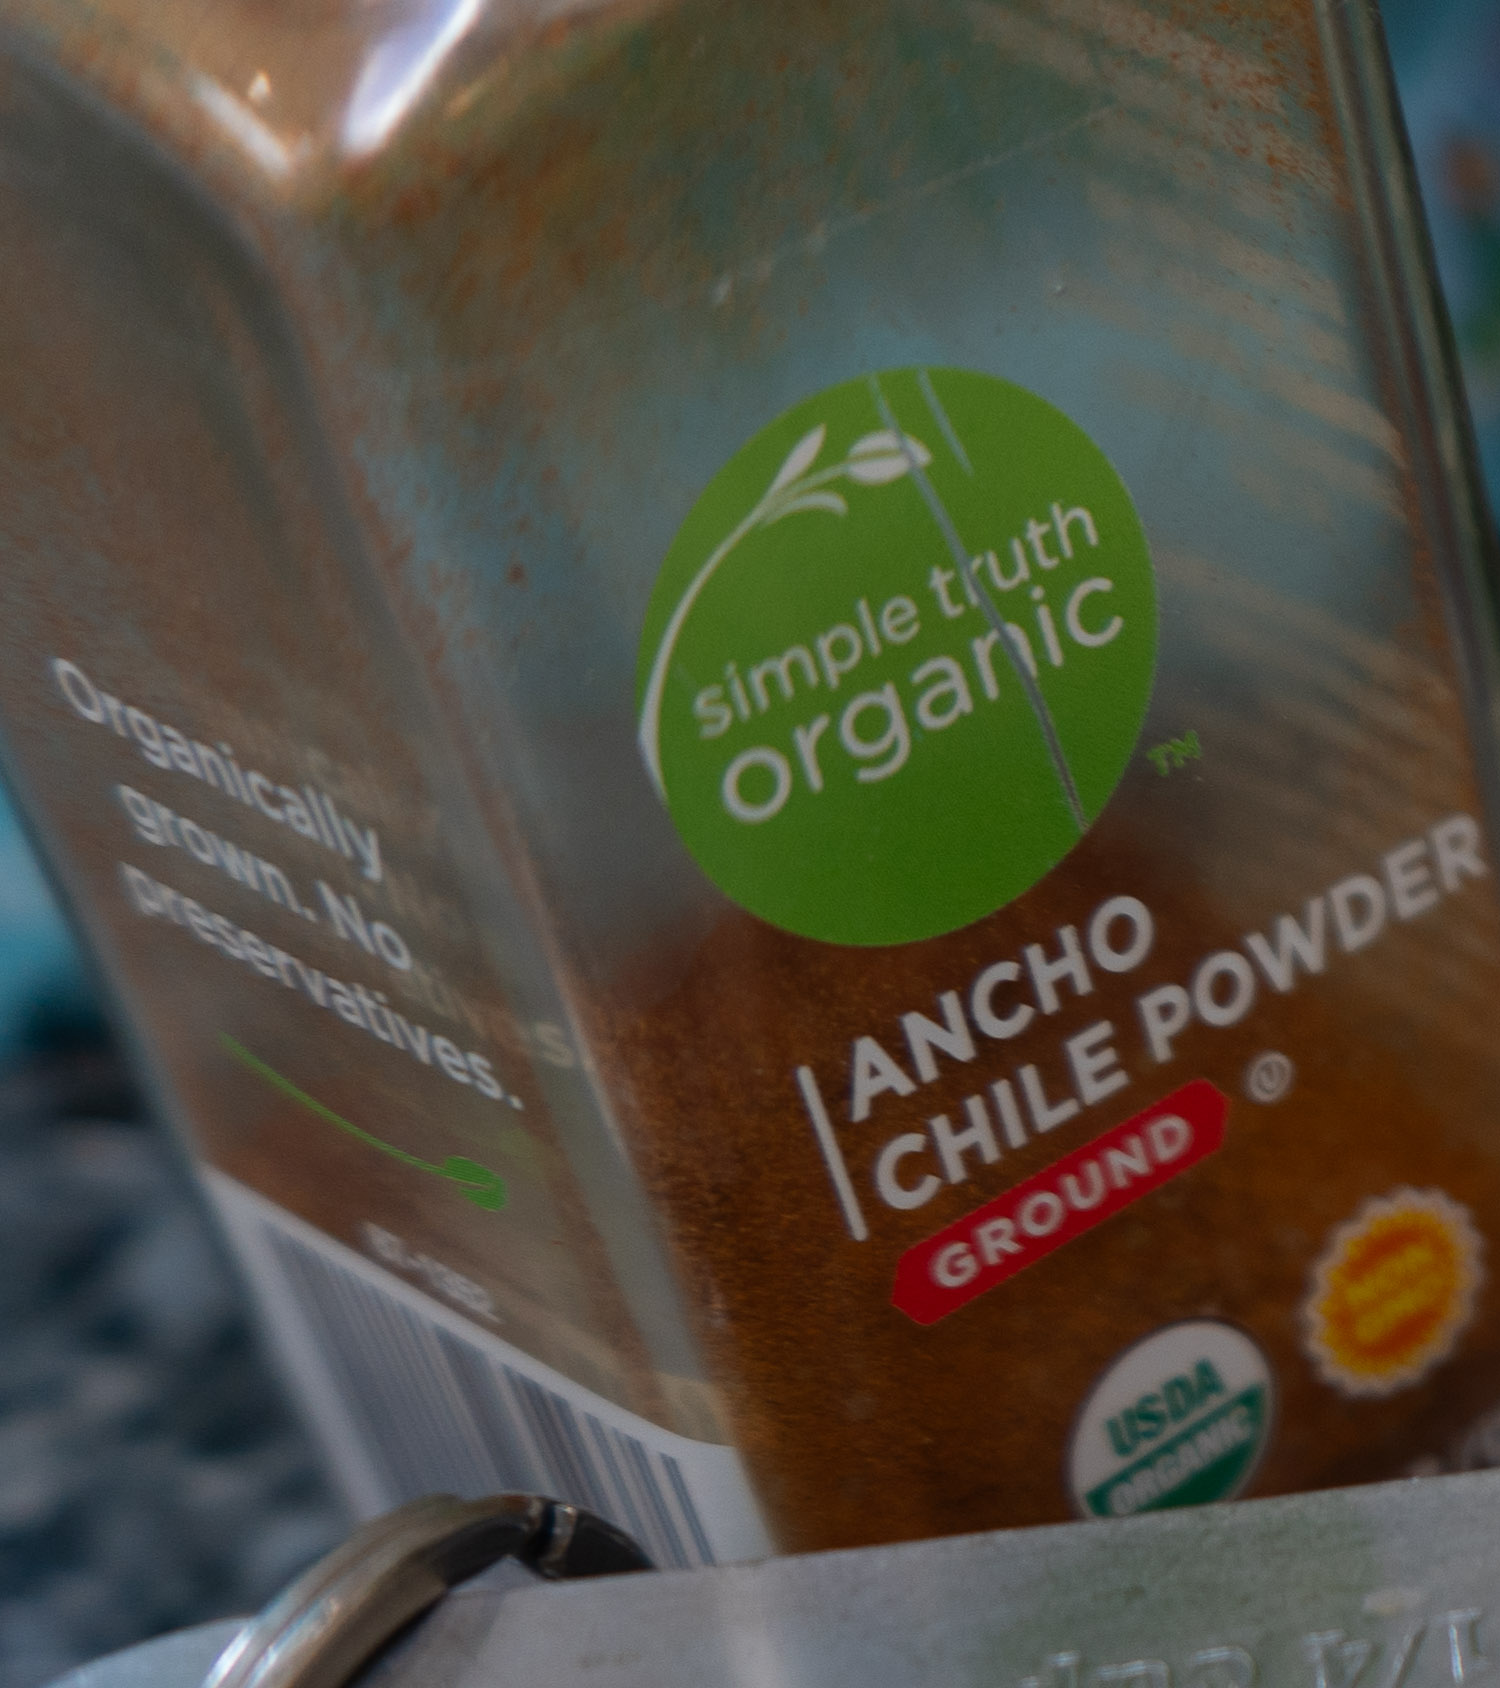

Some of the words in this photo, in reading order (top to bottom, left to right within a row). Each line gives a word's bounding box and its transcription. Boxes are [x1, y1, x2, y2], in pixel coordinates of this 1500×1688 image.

[693, 595, 920, 738] simple
[929, 501, 1098, 618] truth
[720, 576, 1124, 824] organic
[54, 658, 382, 882] Organically
[115, 784, 318, 922] grown.
[314, 880, 412, 972] No
[119, 861, 525, 1111] preservatives.
[847, 895, 1154, 1122] ANCHO
[875, 1020, 1130, 1210] CHILE
[1137, 815, 1488, 1063] POWDER
[929, 1113, 1196, 1291] GROUND
[1104, 1357, 1225, 1457] USDA
[1110, 1403, 1253, 1516] ORGANIC
